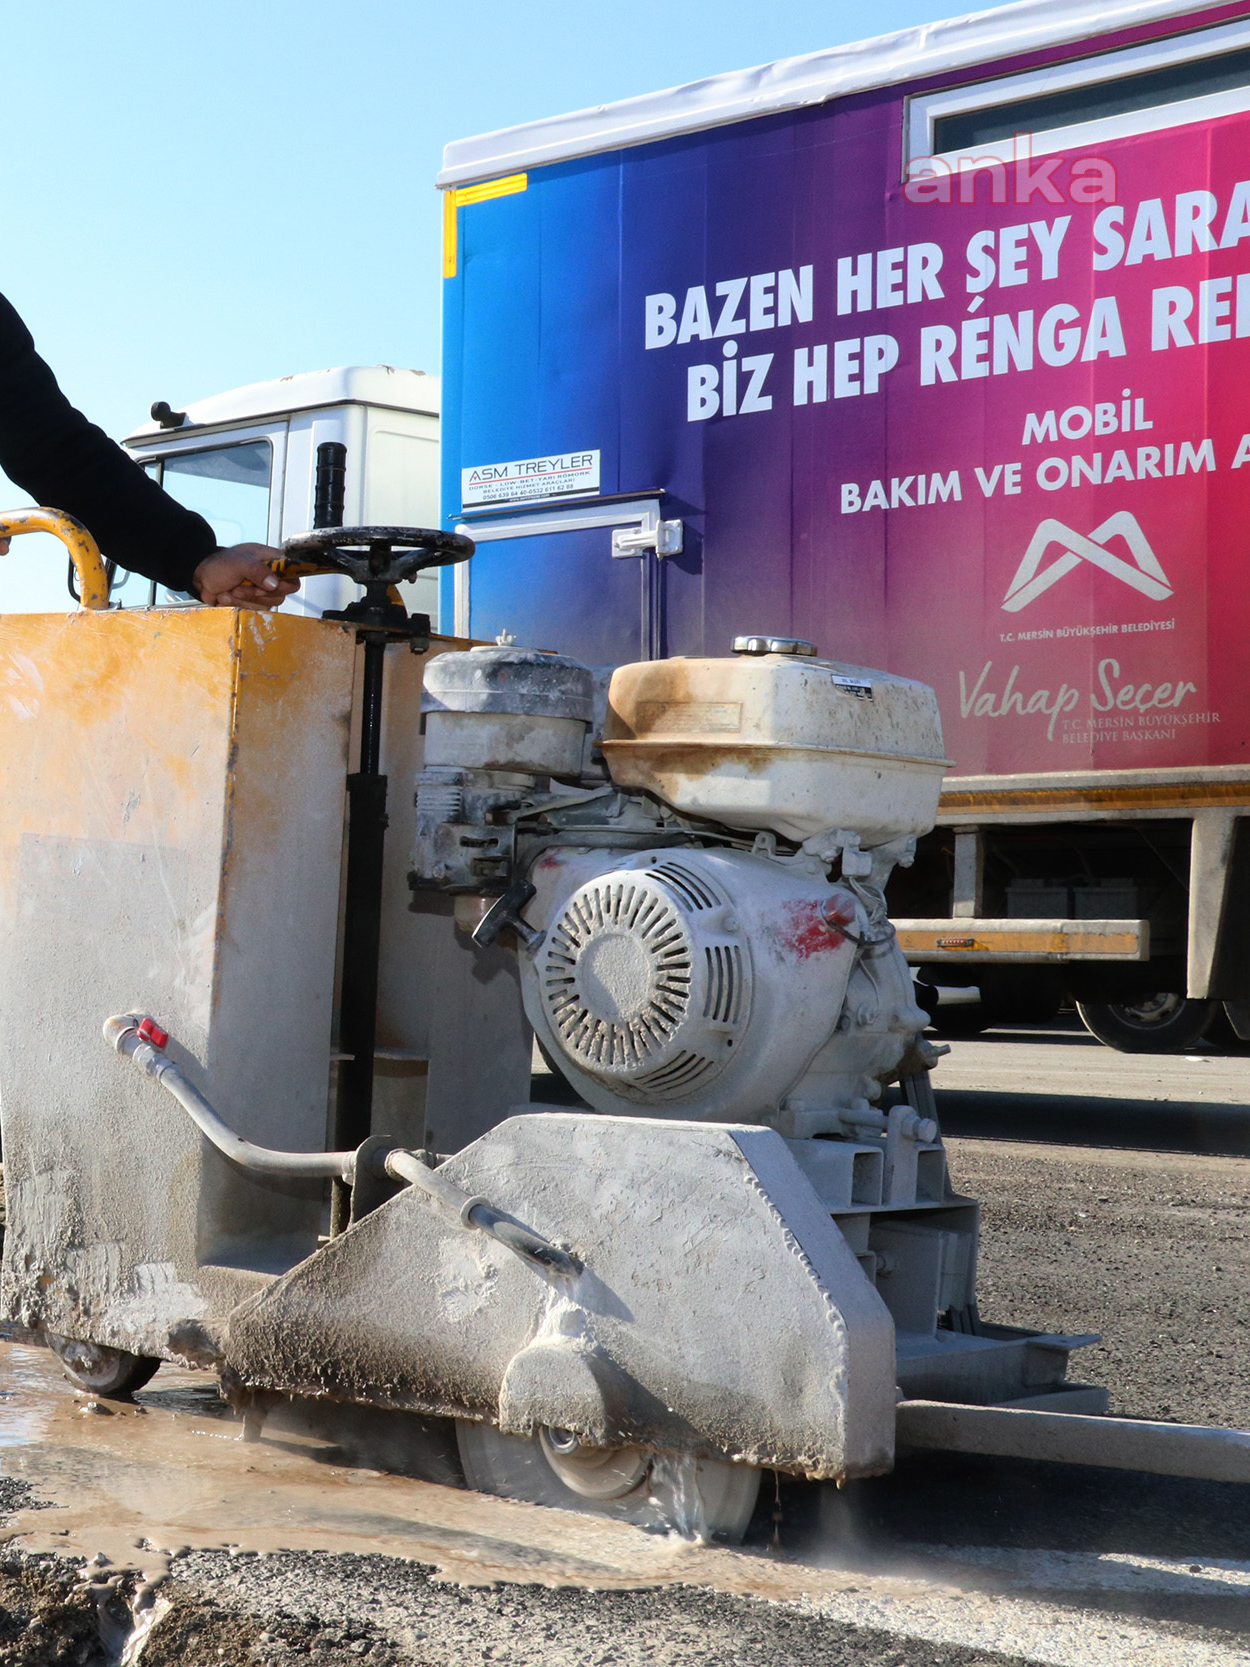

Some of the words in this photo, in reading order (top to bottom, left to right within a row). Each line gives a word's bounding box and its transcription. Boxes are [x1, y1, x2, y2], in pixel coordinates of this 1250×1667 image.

[645, 264, 813, 350] BAZEN
[837, 242, 945, 316] HER
[966, 215, 1072, 313] ŞEY
[687, 340, 775, 422] BİZ
[793, 334, 899, 406] HEP
[1022, 388, 1153, 445] MOBİL
[469, 466, 508, 482] ASM
[514, 454, 593, 475] TREYLER
[841, 470, 962, 514] BAKIM
[974, 462, 1022, 498] VE
[1036, 438, 1216, 491] ONARIM
[999, 632, 1015, 643] T.C.
[1017, 628, 1054, 641] MERSİN
[1056, 622, 1119, 638] BÜYÜKŞEHİR
[1121, 617, 1175, 633] BELEDİYESİ
[959, 661, 1079, 741] Vahap
[1090, 658, 1197, 713] Seçer
